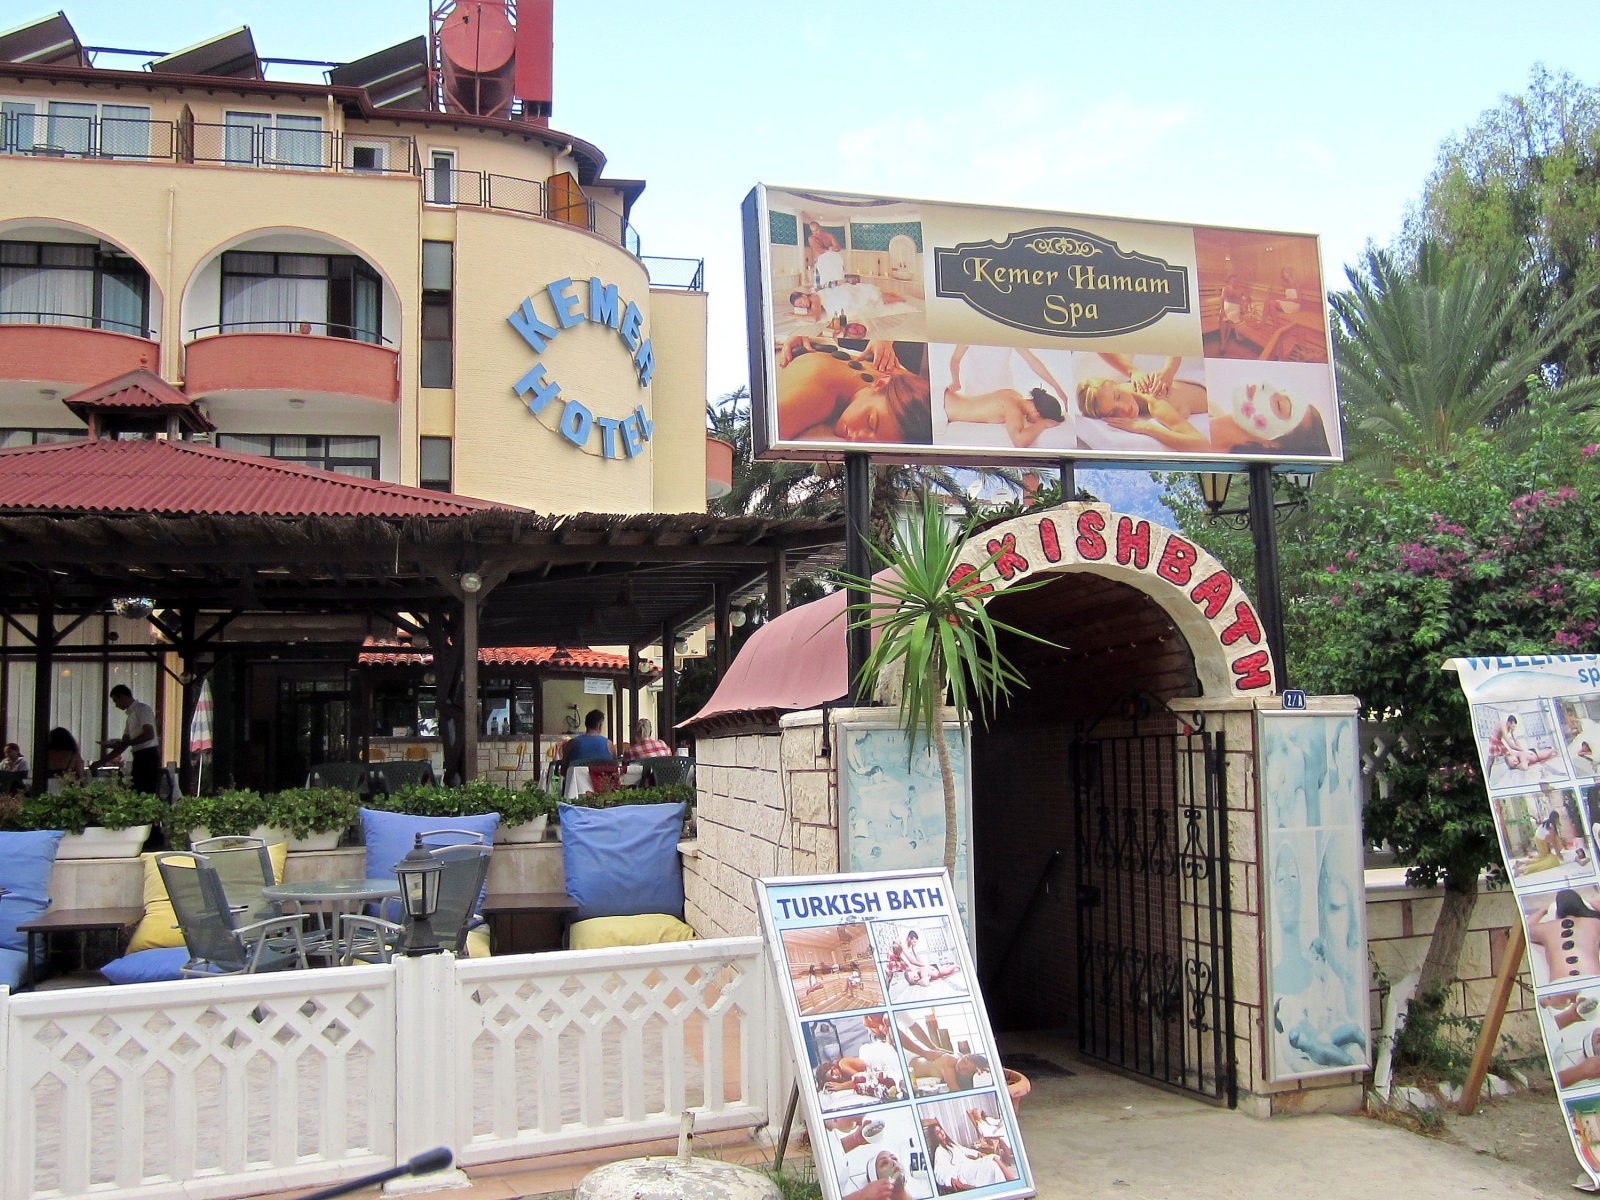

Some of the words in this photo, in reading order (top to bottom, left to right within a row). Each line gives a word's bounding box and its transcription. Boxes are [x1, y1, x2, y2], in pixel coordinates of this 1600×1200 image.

[963, 256, 1058, 294] Kemer
[1067, 264, 1170, 294] Hamam
[507, 276, 655, 388] KEMER
[1043, 294, 1099, 328] Spa
[512, 362, 654, 460] HOTEL
[1156, 534, 1272, 691] BATH
[777, 892, 882, 920] TURKISH
[886, 887, 944, 911] BATH
